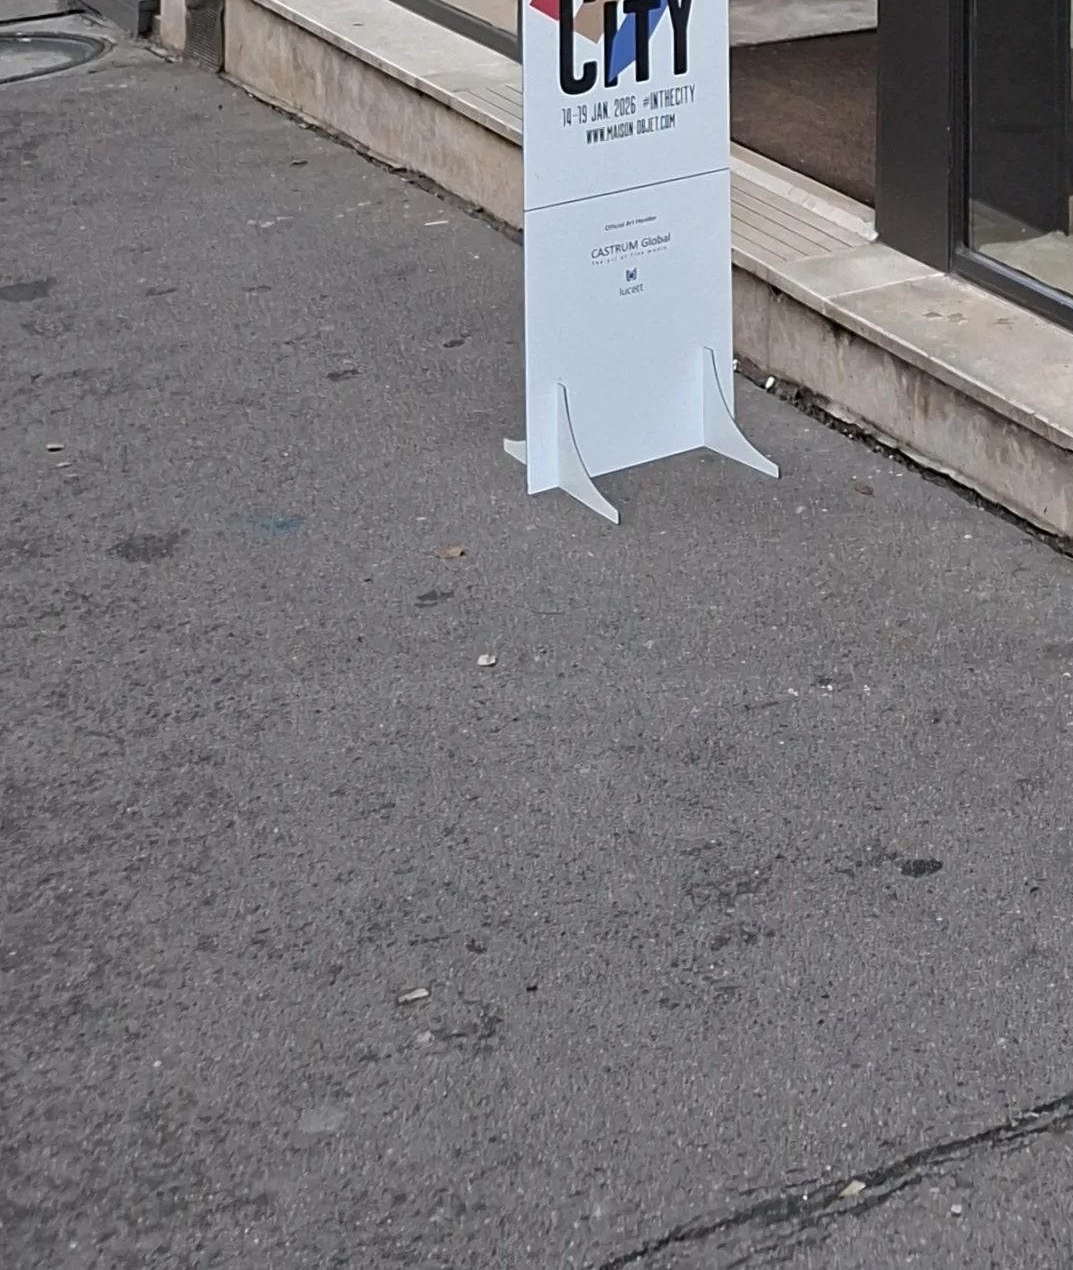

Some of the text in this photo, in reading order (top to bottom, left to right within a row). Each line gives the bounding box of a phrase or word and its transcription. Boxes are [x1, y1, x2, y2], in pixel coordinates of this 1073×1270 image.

[562, 105, 588, 128] 14-19
[614, 95, 637, 115] 2026
[642, 84, 696, 111] #INTHECITY
[591, 232, 671, 259] CASTRUM Global
